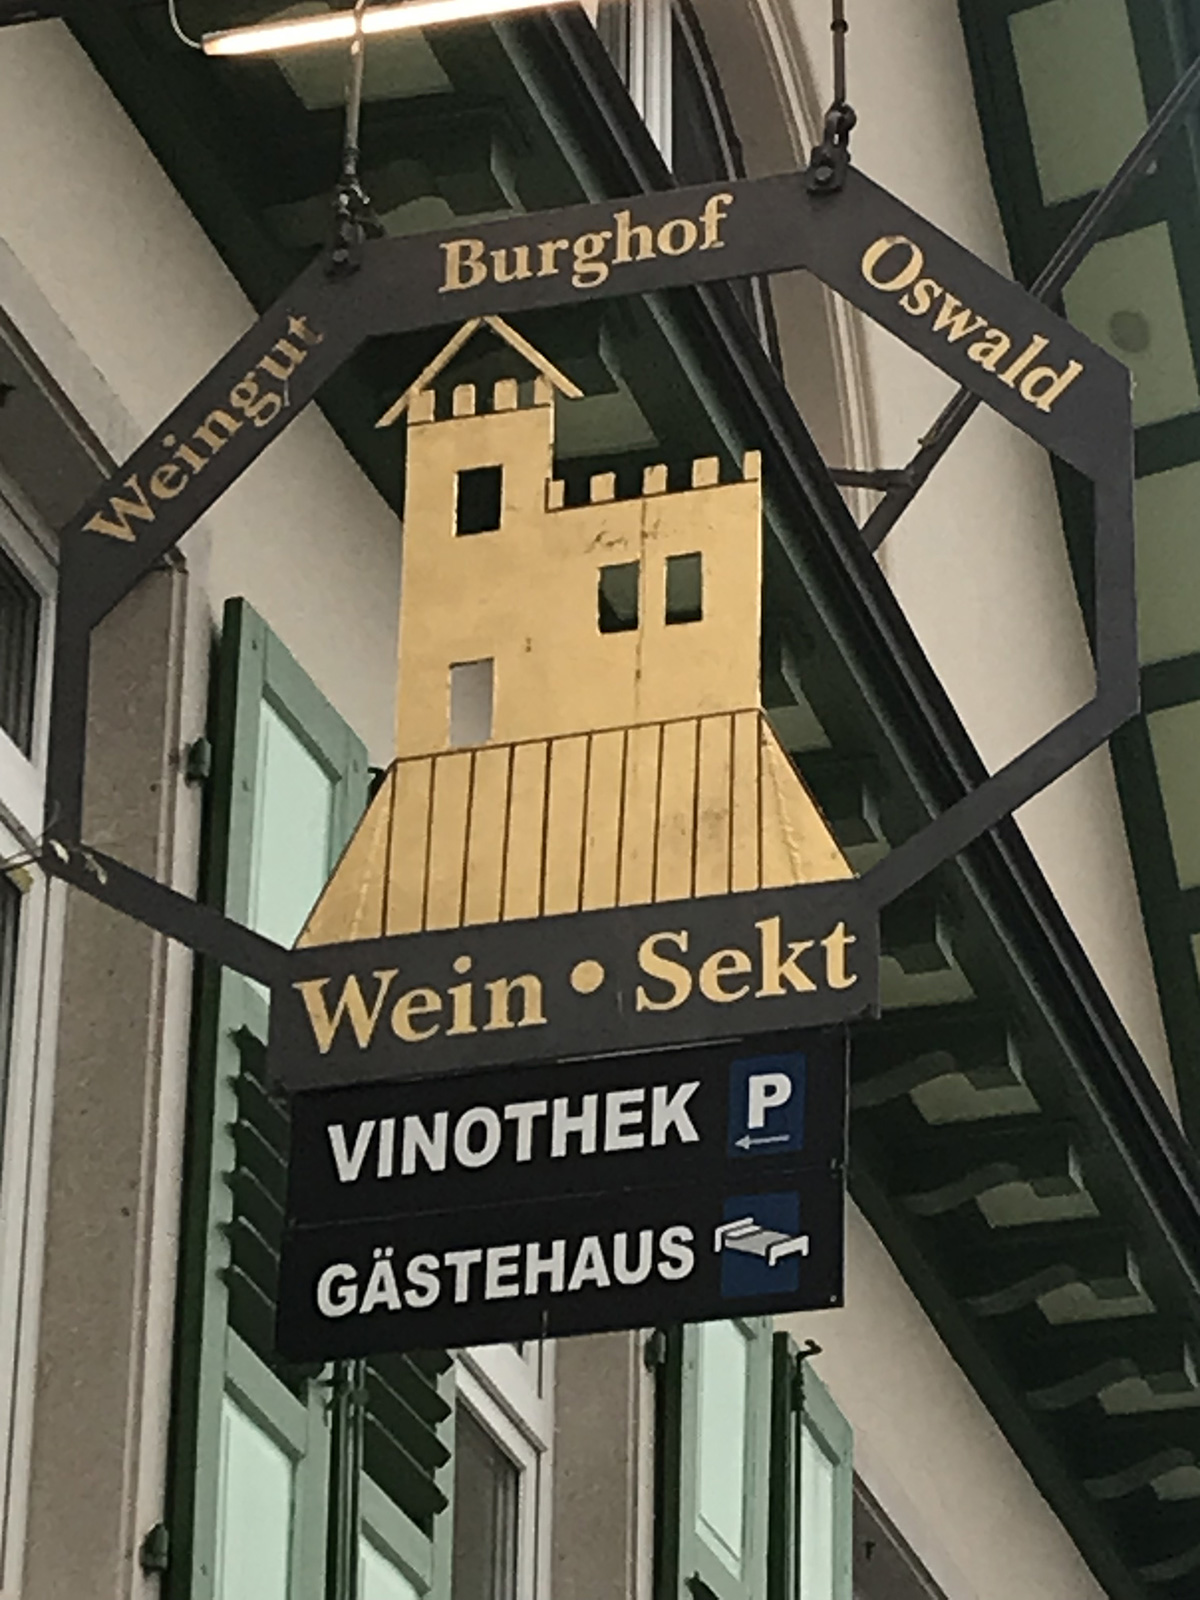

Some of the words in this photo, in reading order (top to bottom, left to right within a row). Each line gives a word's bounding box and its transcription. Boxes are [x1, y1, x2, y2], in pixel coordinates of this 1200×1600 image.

[82, 313, 324, 546] Weingut
[438, 194, 734, 293] Burghof
[861, 235, 1083, 413] Oswald
[294, 956, 547, 1054] Wein
[636, 916, 857, 1012] Sekt
[327, 1081, 701, 1183] VINOTHEK
[748, 1073, 792, 1128] P
[316, 1226, 695, 1317] GÄSTEHAUS
